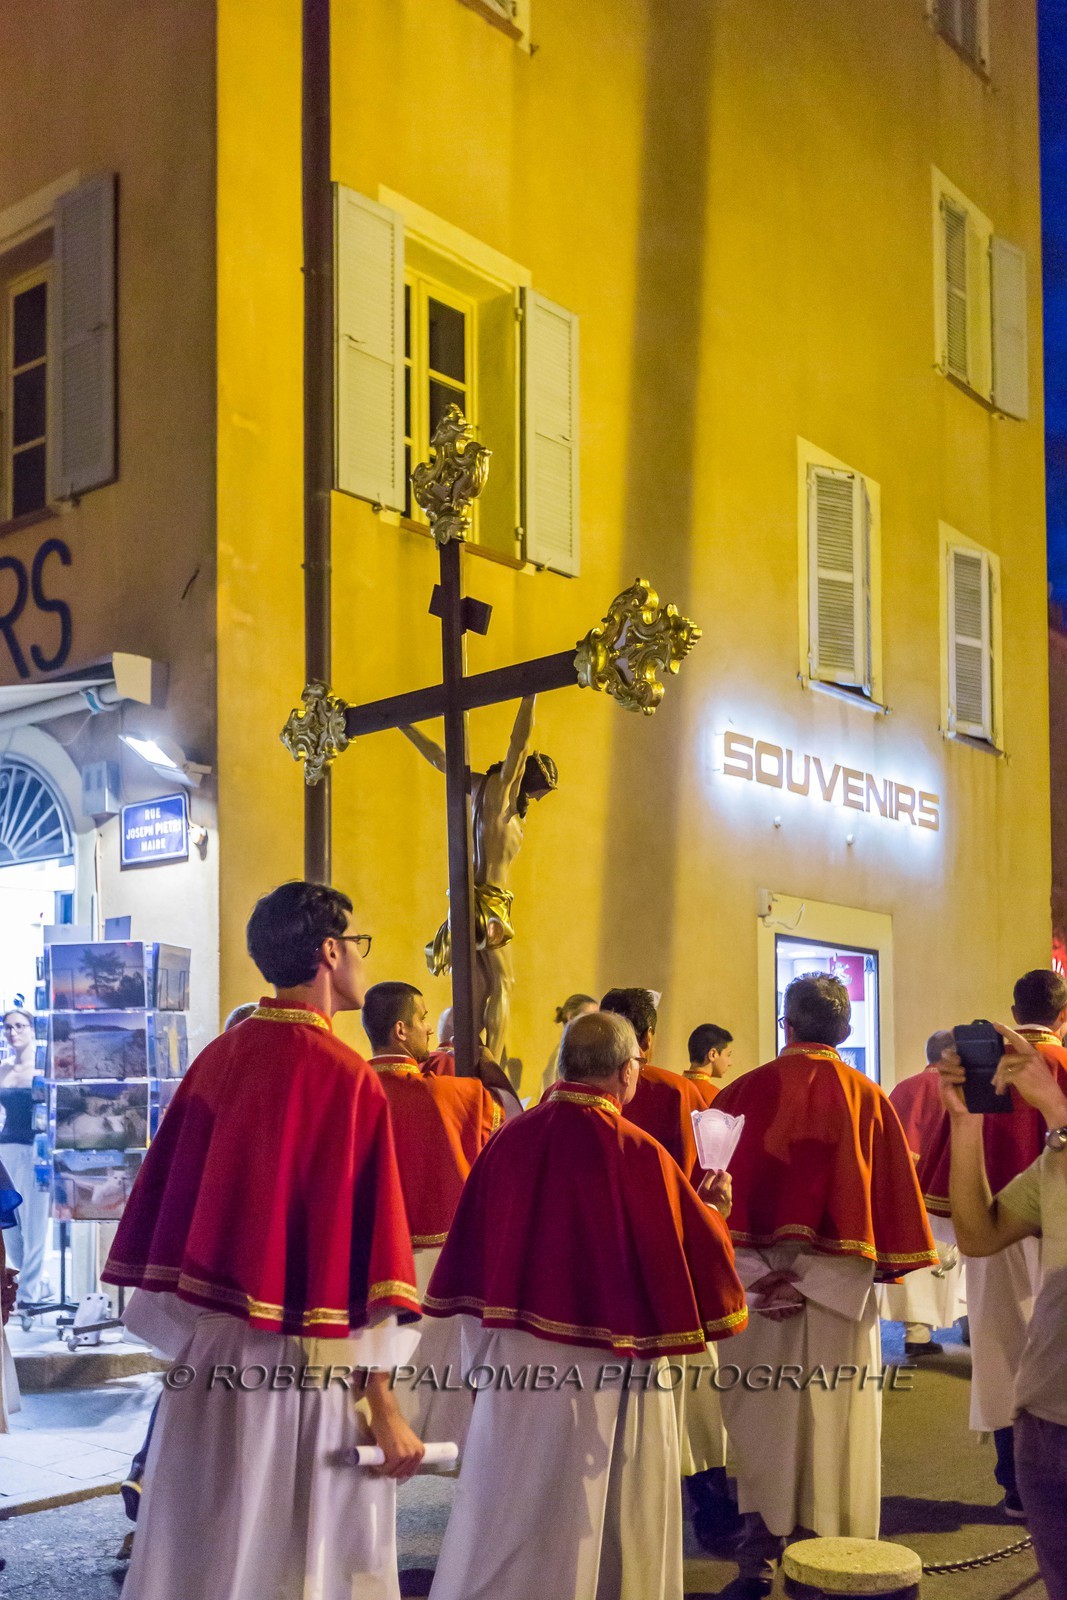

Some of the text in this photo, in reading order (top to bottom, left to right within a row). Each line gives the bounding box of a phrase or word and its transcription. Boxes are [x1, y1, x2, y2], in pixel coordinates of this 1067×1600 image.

[723, 731, 939, 831] SOUVENIRS
[144, 807, 161, 820] RUE
[126, 824, 154, 840] JOSEPH
[141, 837, 166, 851] MAIRE
